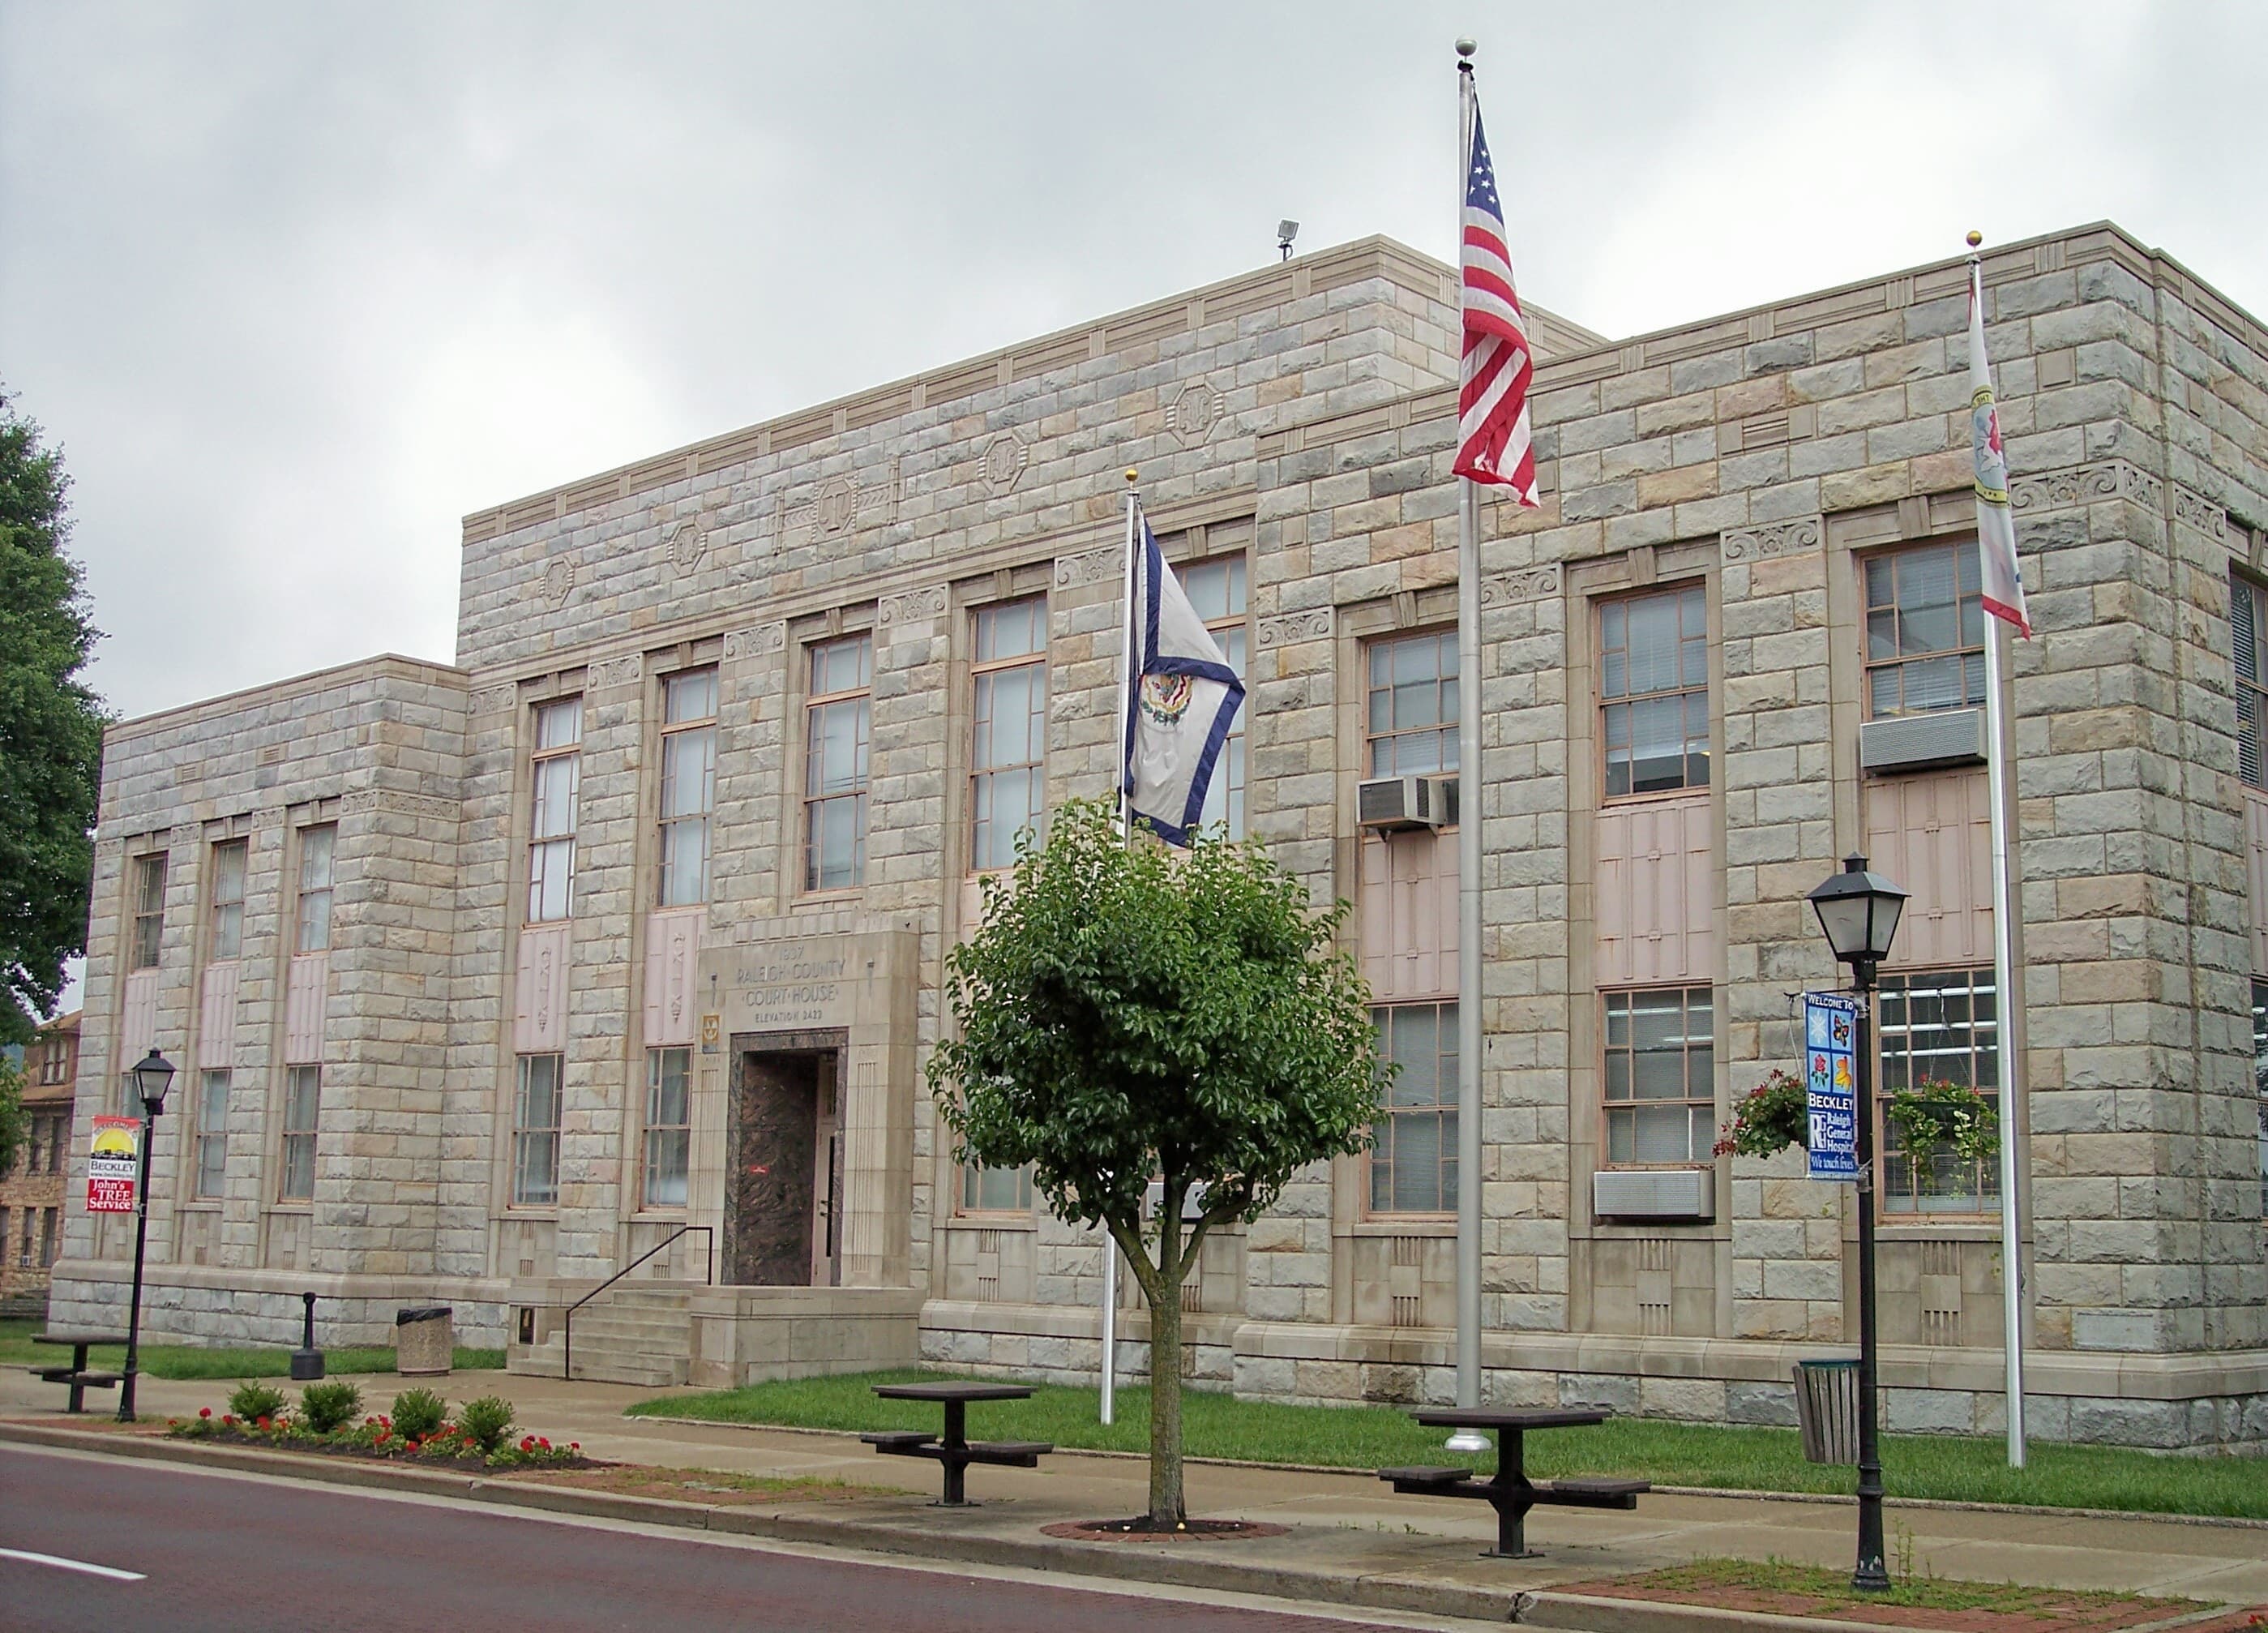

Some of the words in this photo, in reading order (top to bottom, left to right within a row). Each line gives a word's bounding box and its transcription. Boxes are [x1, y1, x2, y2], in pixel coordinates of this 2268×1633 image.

[738, 965, 786, 984] RALEIGH
[793, 959, 845, 979] COUNTY
[747, 988, 788, 1006] COURT
[792, 984, 836, 1003] HOUSE
[1808, 993, 1842, 1009] WELCOME
[1843, 1000, 1853, 1010] TO
[755, 1010, 799, 1023] ELEVATION
[1809, 1092, 1853, 1111] BECKLEY
[1827, 1112, 1851, 1128] Raleigh
[1827, 1125, 1853, 1139] General
[1827, 1139, 1855, 1155] Hospital
[91, 1161, 135, 1172] BECKLEY
[1824, 1155, 1838, 1168] touch
[92, 1180, 125, 1191] John's
[97, 1189, 130, 1201] TREE
[89, 1197, 131, 1210] Service
